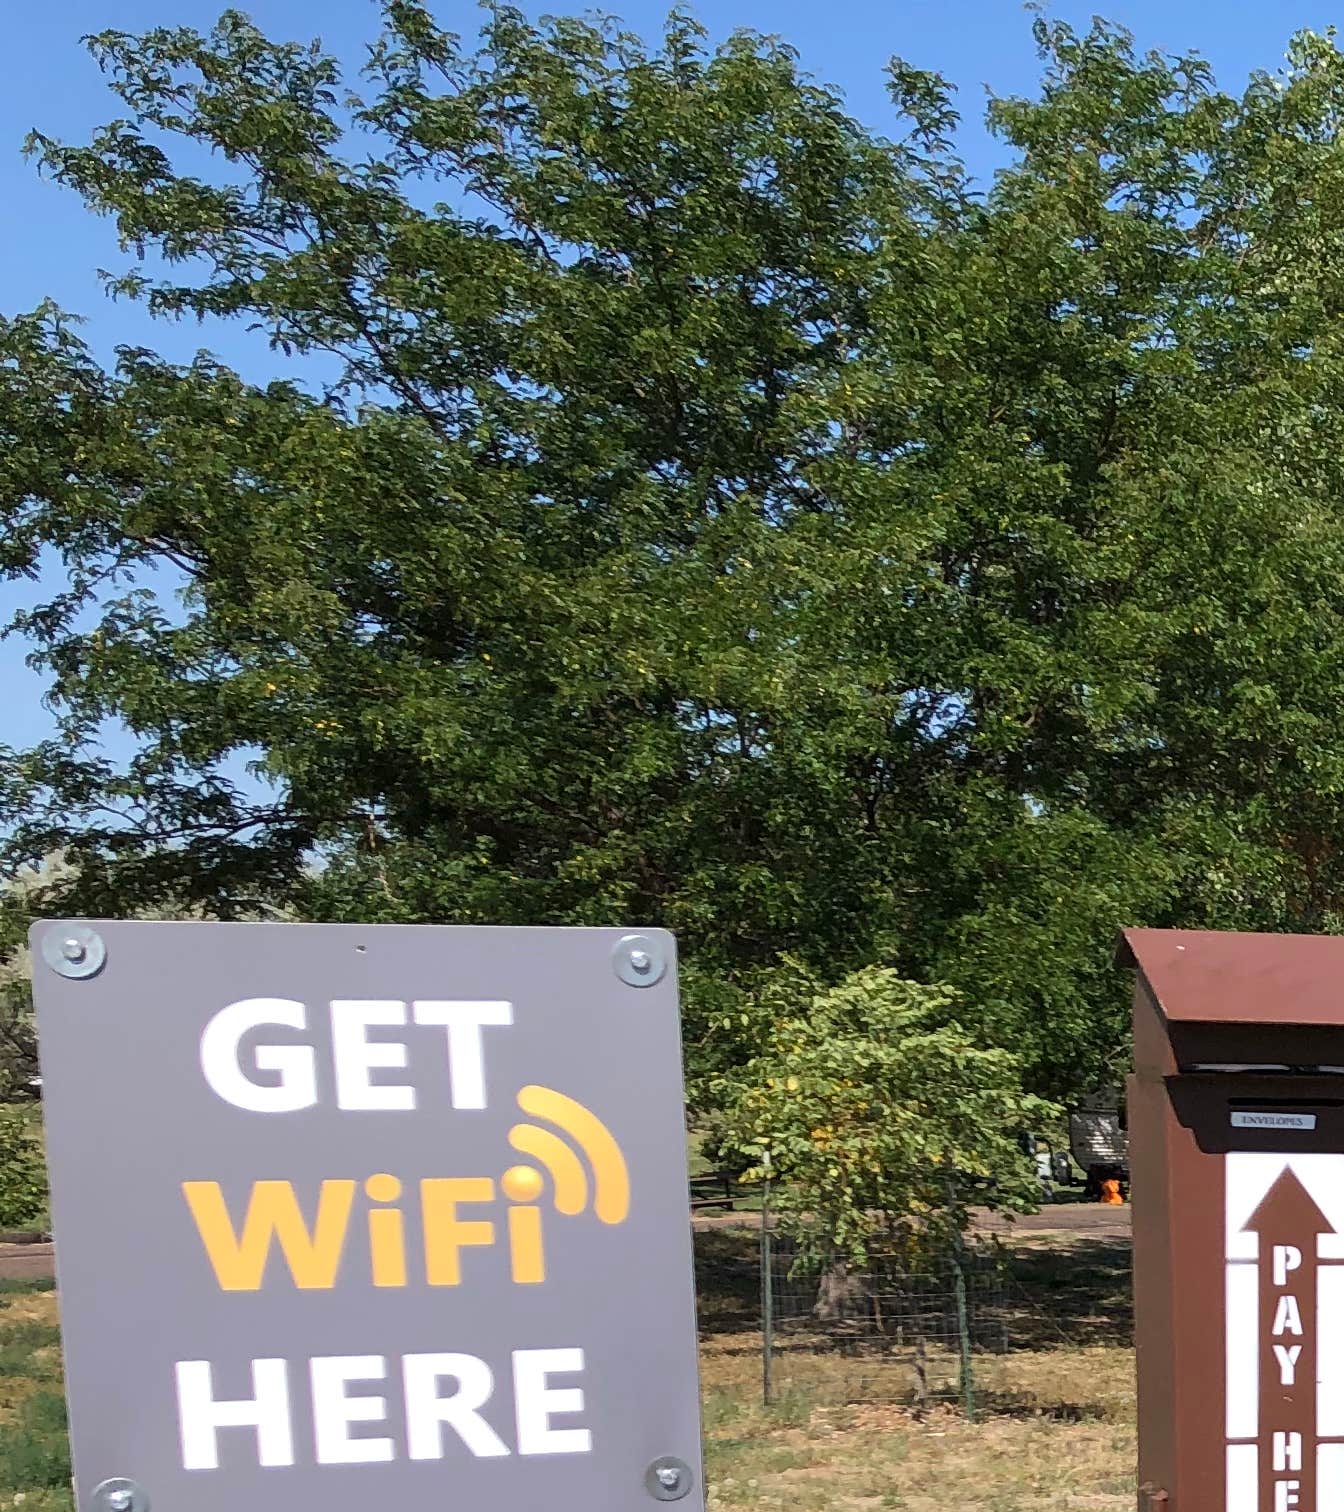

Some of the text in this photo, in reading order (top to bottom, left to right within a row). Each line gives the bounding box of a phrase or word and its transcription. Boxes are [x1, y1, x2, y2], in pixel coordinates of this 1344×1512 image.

[200, 998, 513, 1112] GET
[184, 1165, 545, 1290] WiFi
[1272, 1246, 1302, 1386] PAY
[176, 1348, 591, 1469] HERE
